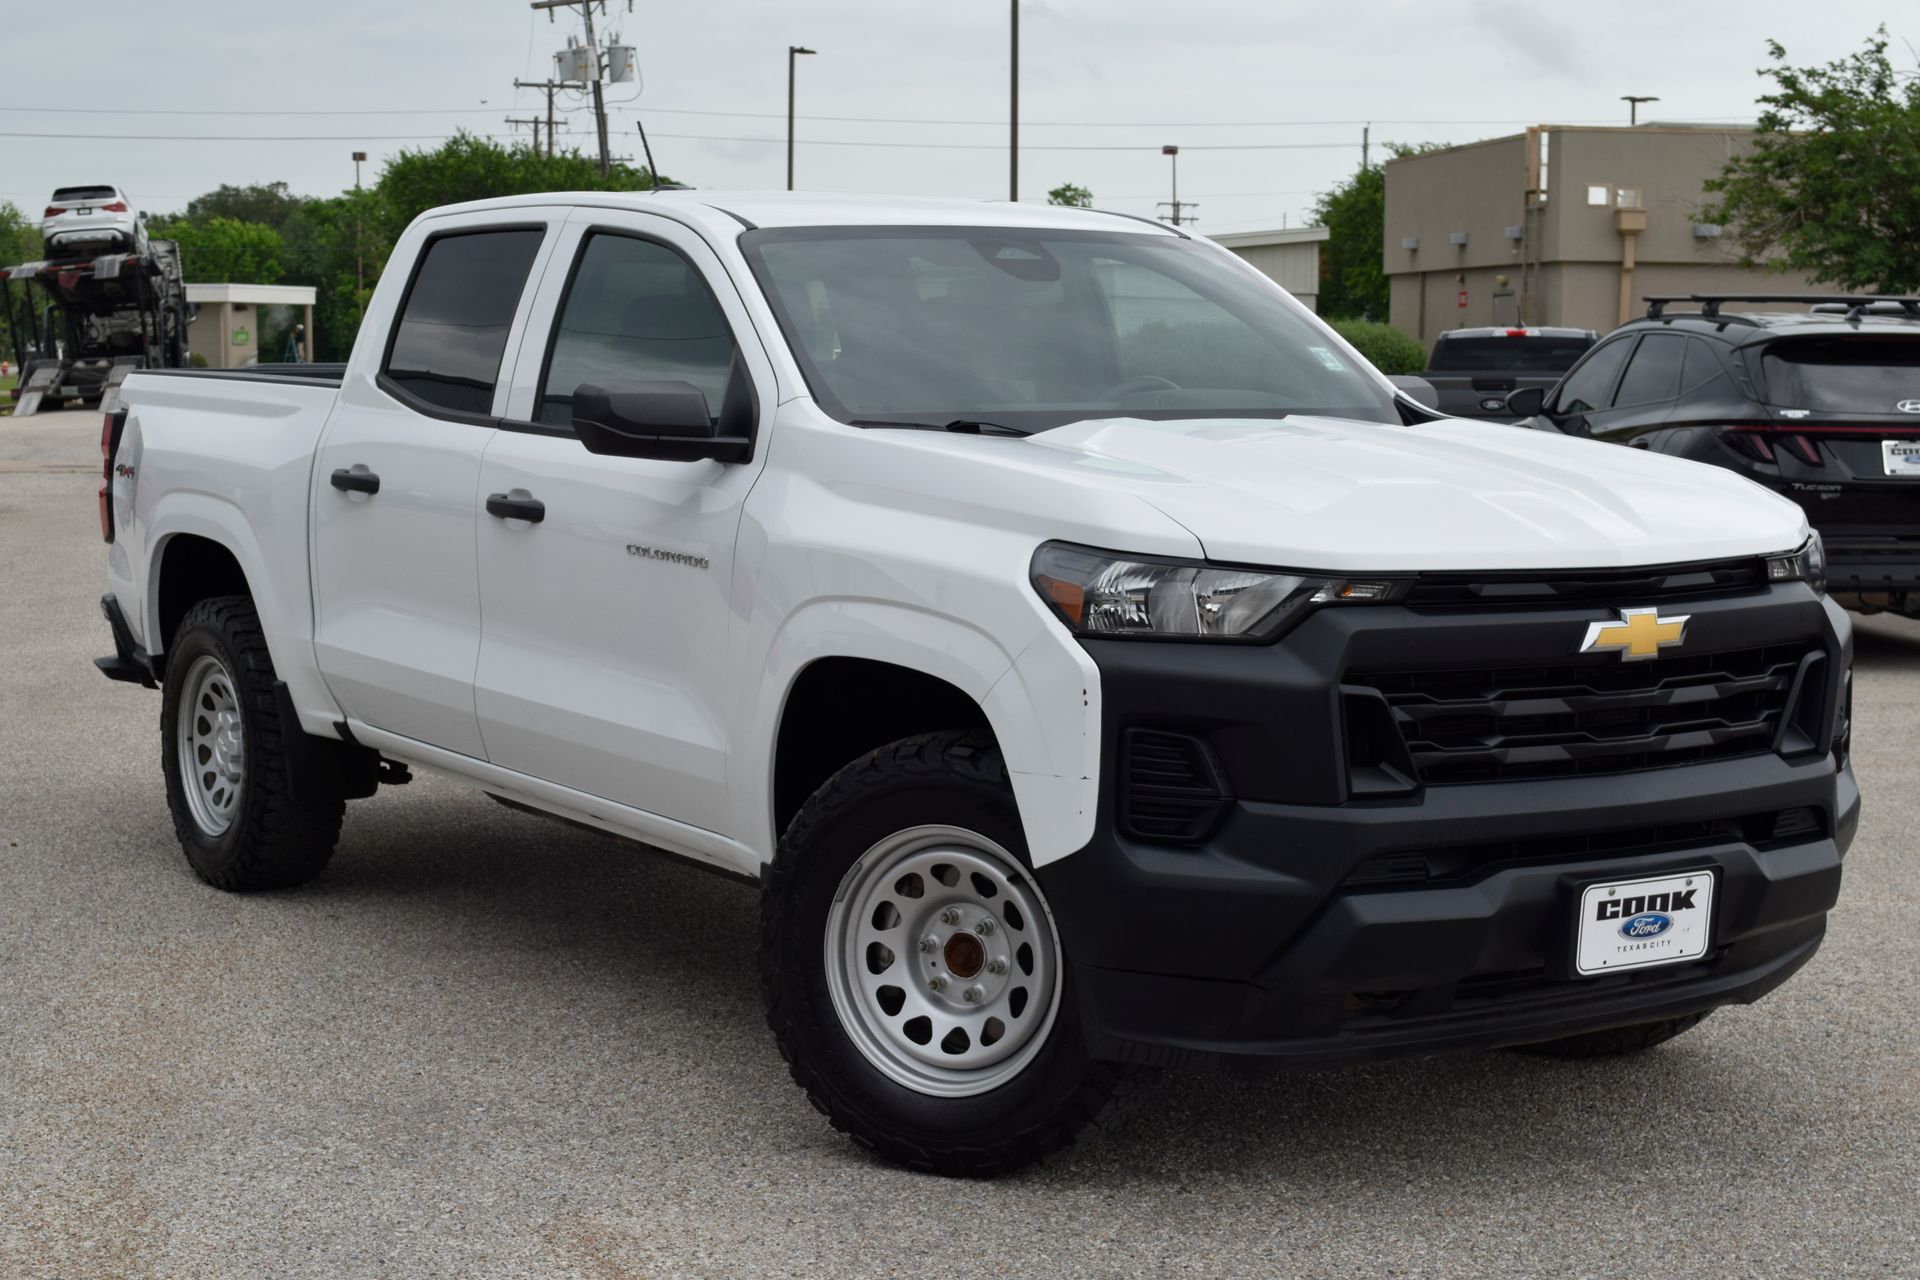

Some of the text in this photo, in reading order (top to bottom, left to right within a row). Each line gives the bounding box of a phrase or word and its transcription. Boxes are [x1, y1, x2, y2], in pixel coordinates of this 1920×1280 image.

[626, 544, 709, 569] COLORADO
[1596, 888, 1698, 921] COOK
[1629, 917, 1661, 936] Ford
